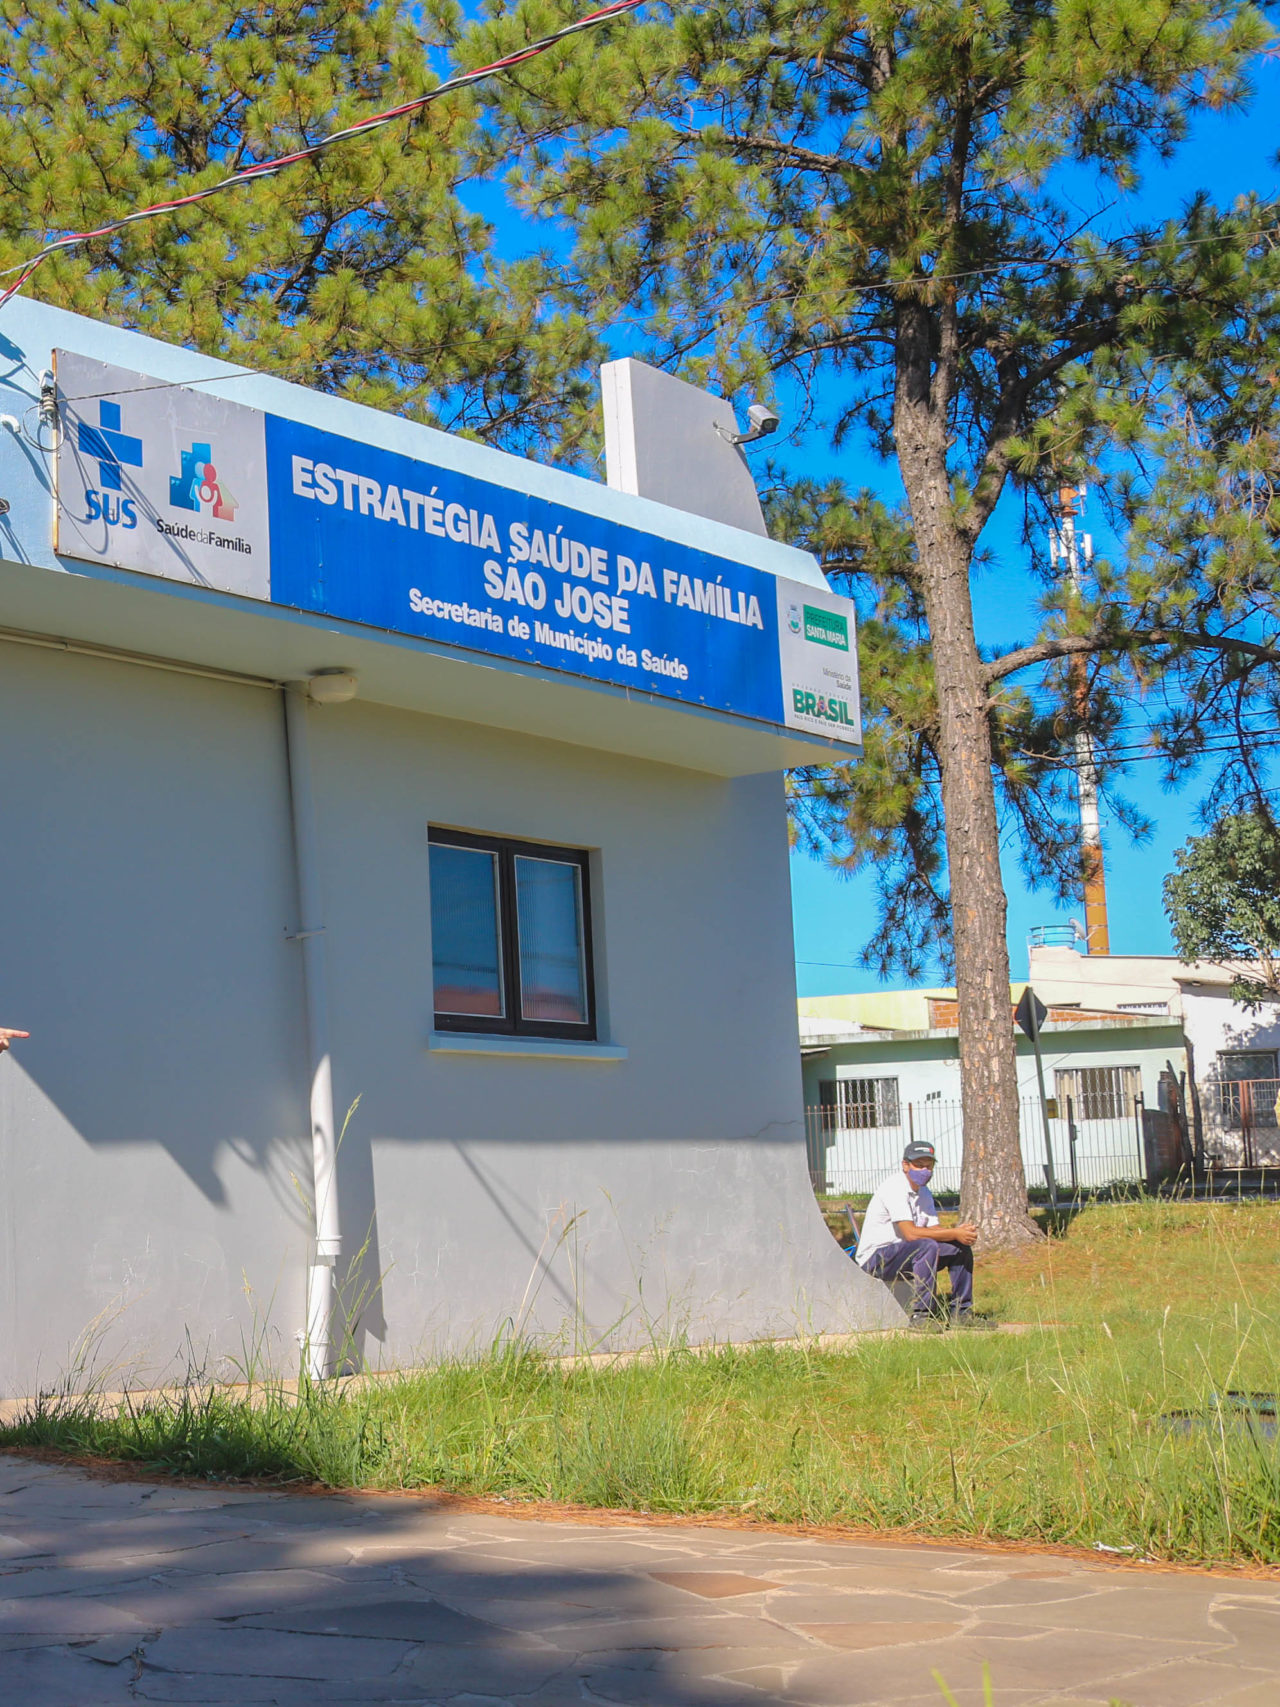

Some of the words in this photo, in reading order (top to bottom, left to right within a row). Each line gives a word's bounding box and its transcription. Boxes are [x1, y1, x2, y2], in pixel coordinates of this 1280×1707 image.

[85, 489, 137, 529] SUS
[291, 454, 501, 554] ESTRATÉGIA
[508, 521, 610, 586] SAÚDE
[616, 554, 658, 599] DA
[663, 569, 764, 630] FAMÍLIA
[483, 556, 547, 611] SÃO
[555, 584, 631, 635] JOSÉ
[409, 587, 504, 634] Secretaria
[508, 615, 531, 640] de
[534, 619, 613, 664] Município
[616, 643, 638, 668] da
[641, 648, 689, 681] Saúde
[806, 624, 827, 641] SANTA
[792, 688, 855, 727] BRASIL
